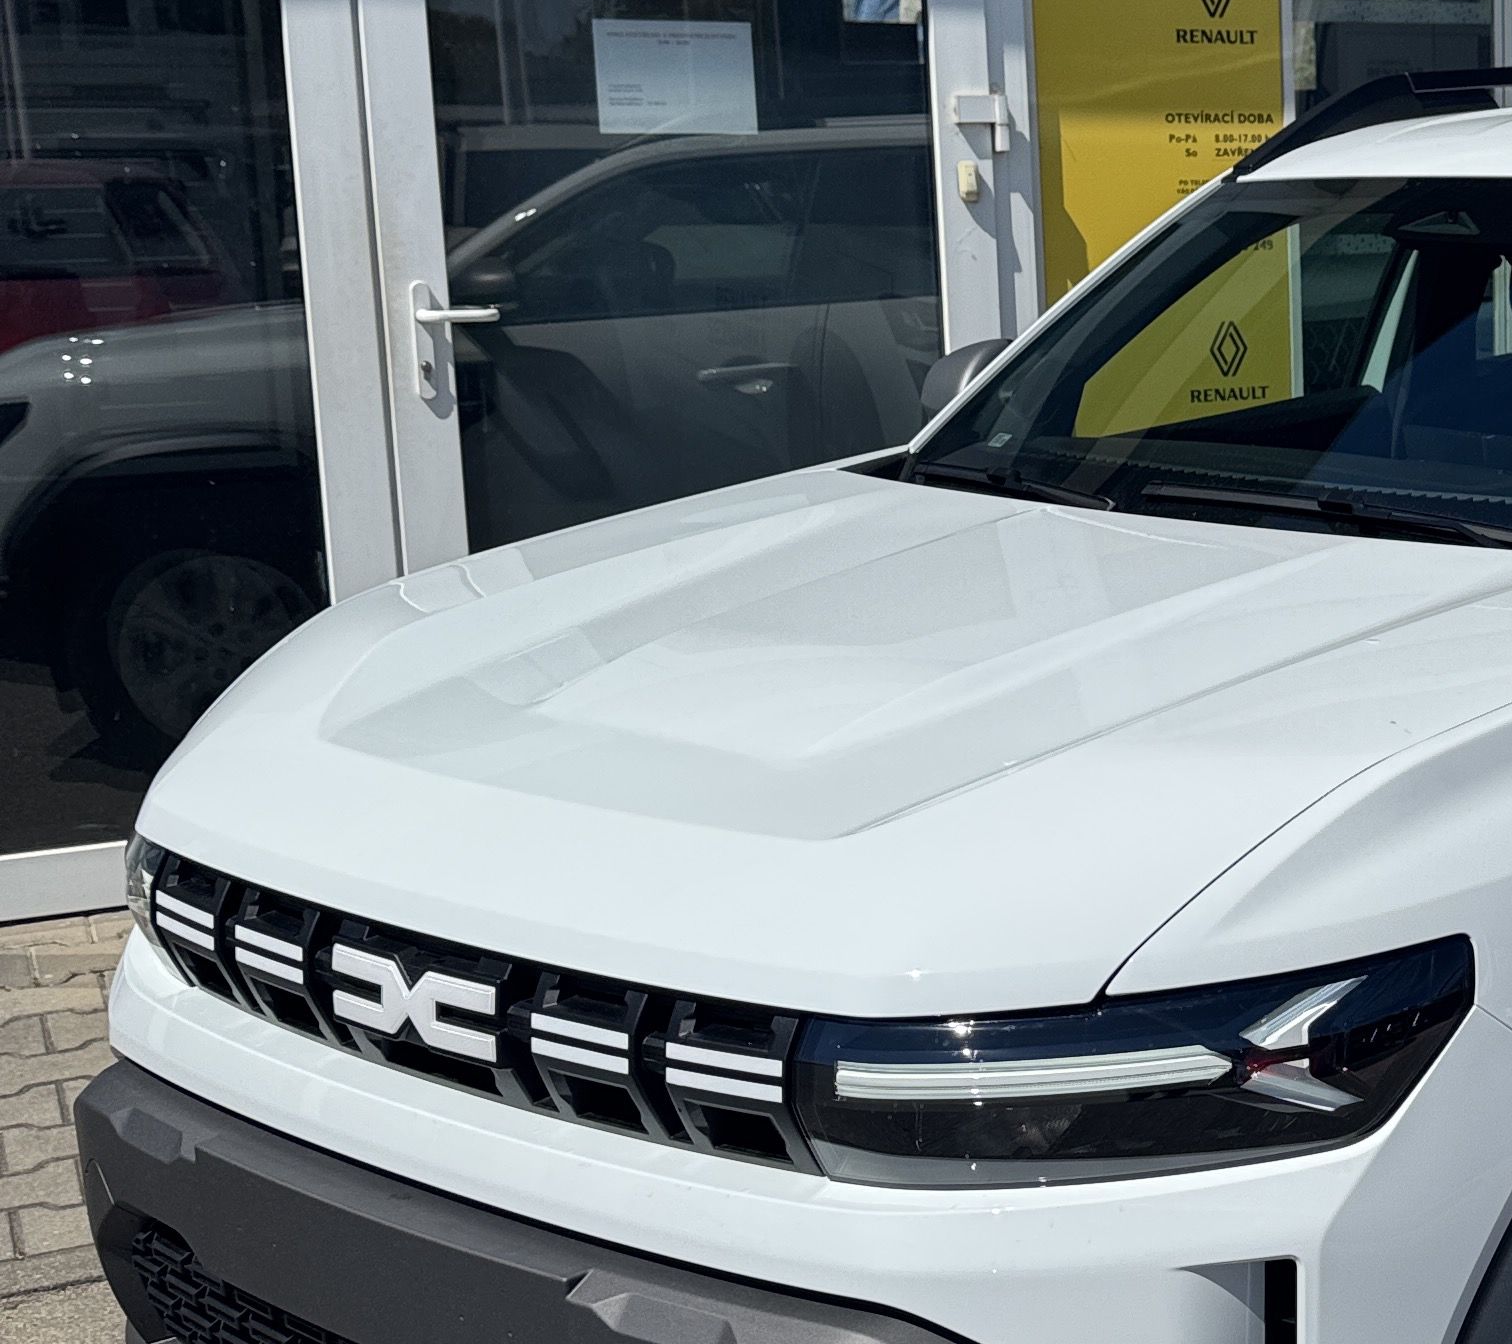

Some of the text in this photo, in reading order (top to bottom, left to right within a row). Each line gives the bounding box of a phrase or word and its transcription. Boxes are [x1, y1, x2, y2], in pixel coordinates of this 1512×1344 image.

[1175, 28, 1258, 45] RENAULT
[1165, 109, 1274, 124] OTEVÍRACÍ DOBA
[1184, 147, 1198, 158] So
[1190, 385, 1270, 403] RENAULT
